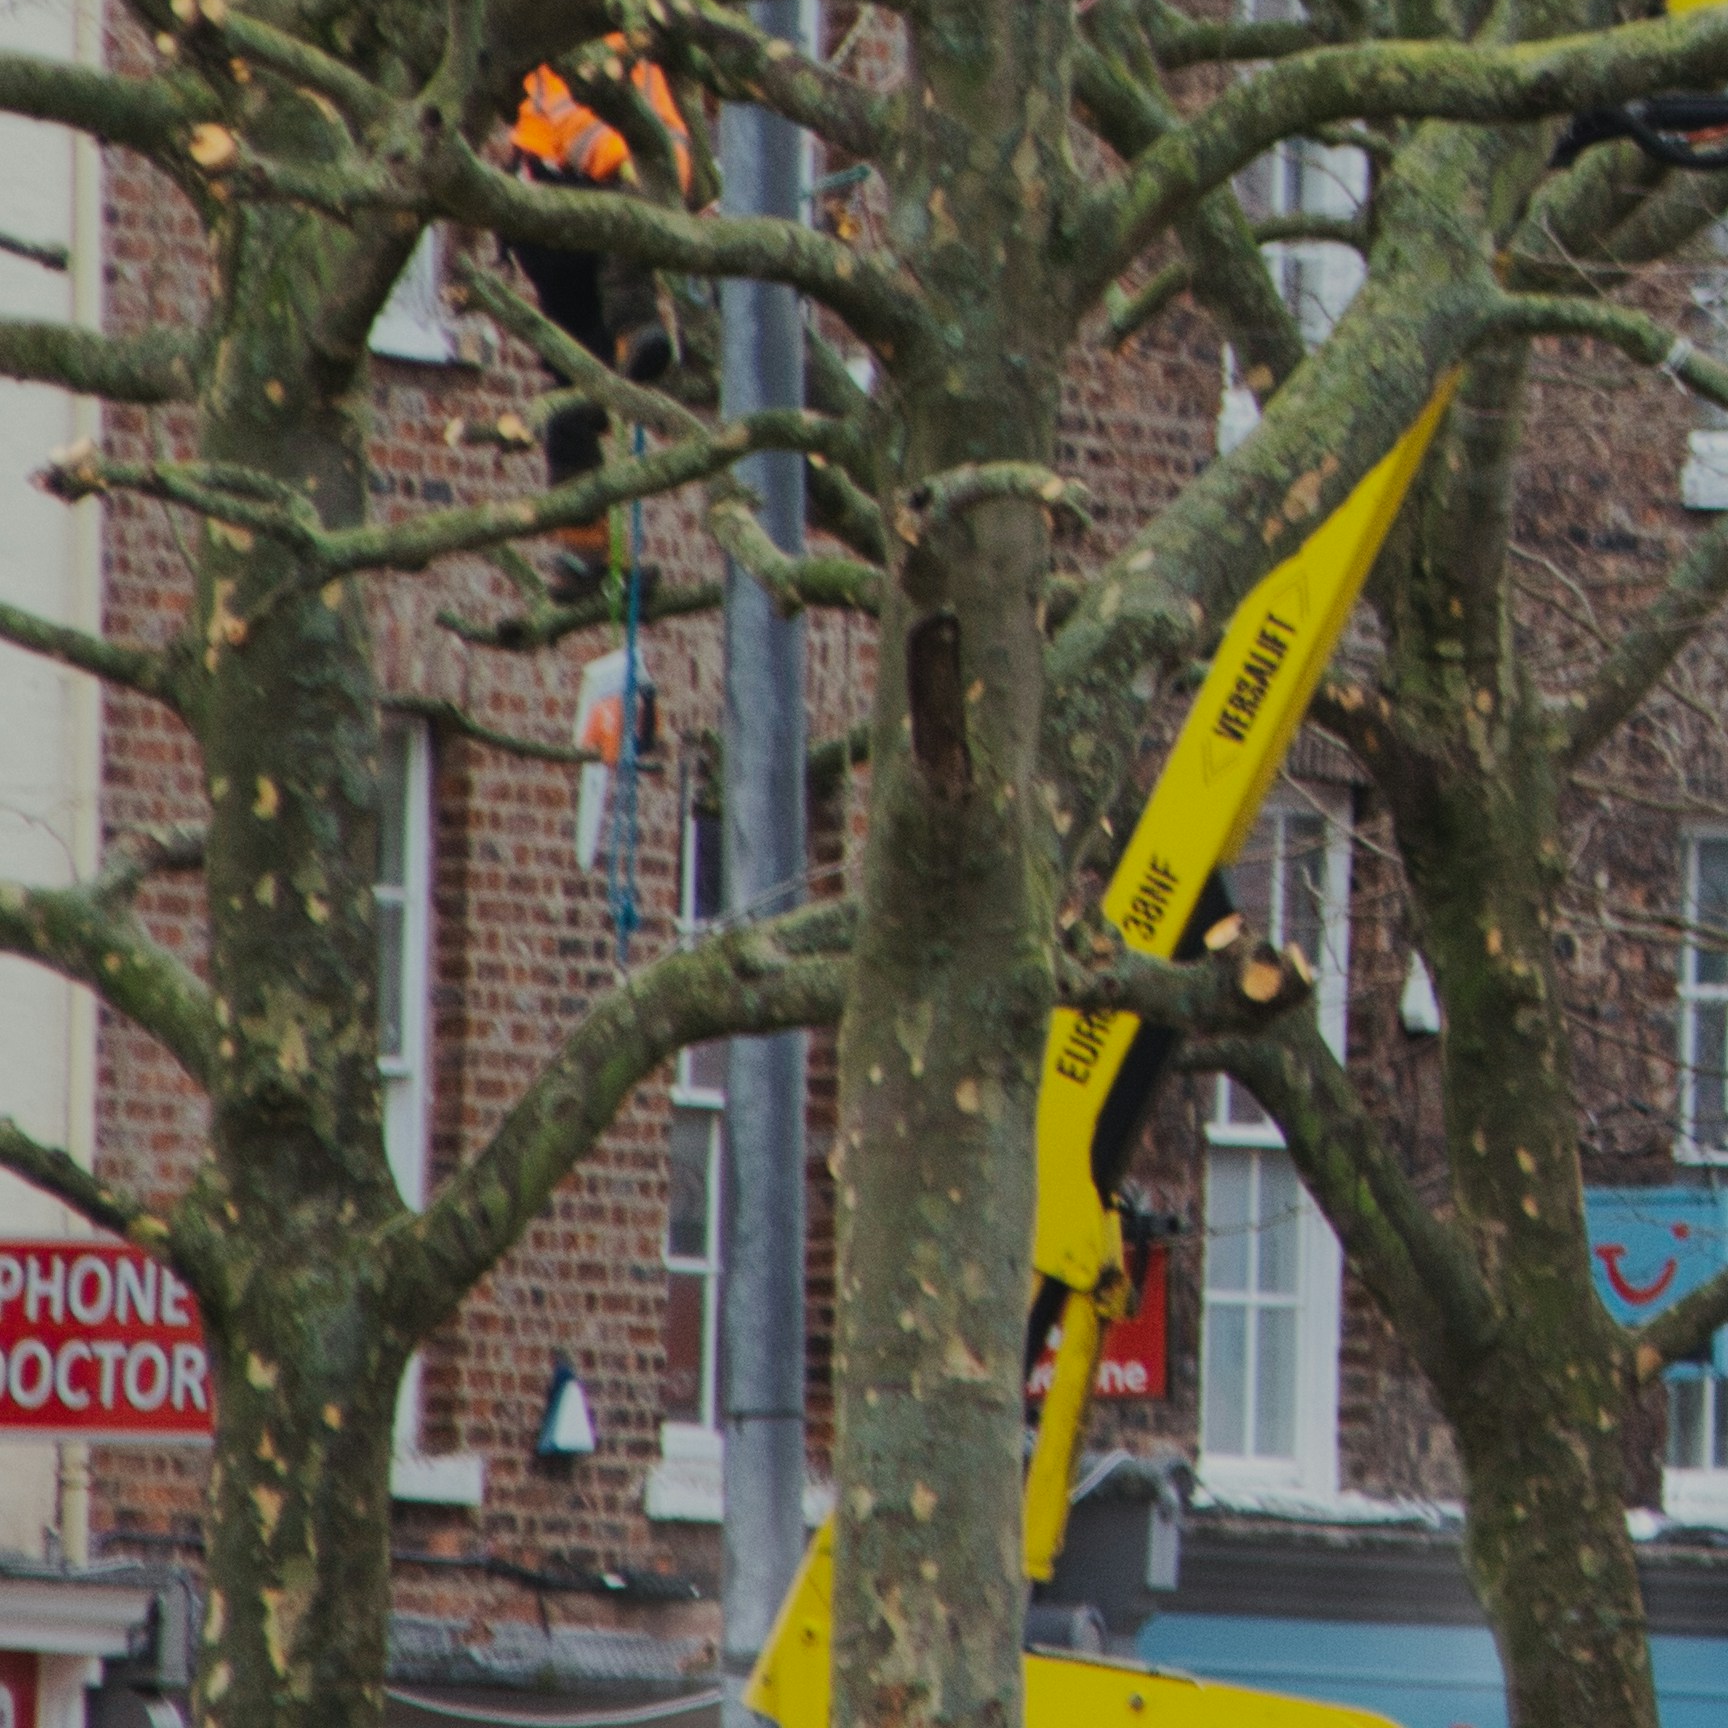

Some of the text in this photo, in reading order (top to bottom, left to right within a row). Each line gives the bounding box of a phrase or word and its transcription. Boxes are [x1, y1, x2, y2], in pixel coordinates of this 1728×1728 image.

[1213, 611, 1296, 744] VERSALIFT
[1122, 854, 1180, 943] 38NF
[0, 1338, 207, 1412] OCTOR
